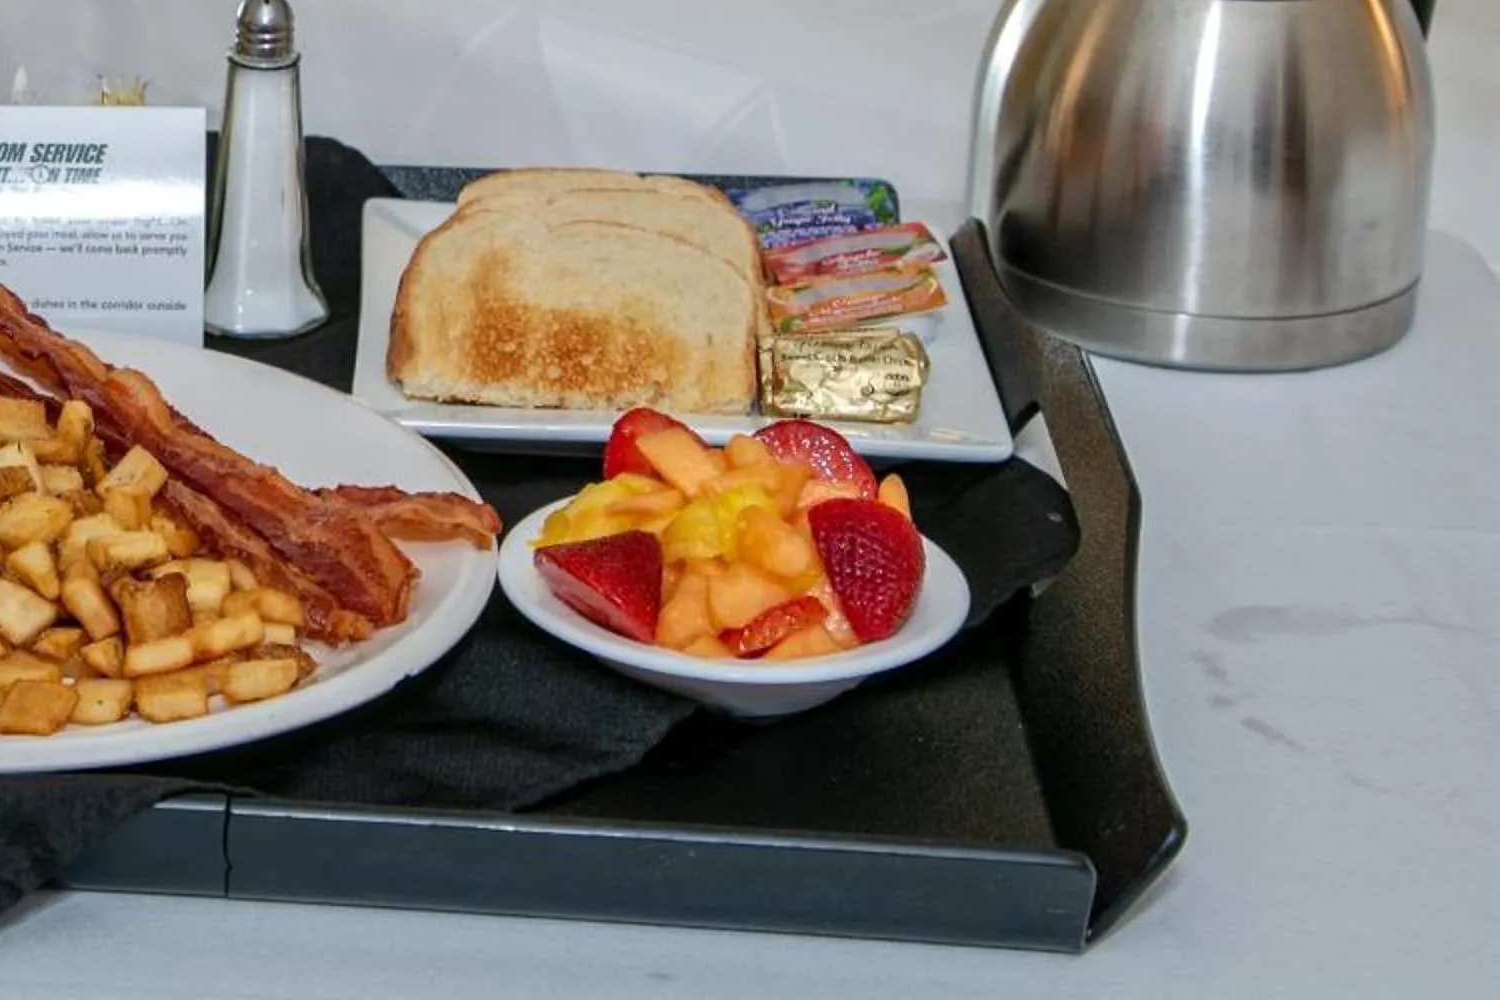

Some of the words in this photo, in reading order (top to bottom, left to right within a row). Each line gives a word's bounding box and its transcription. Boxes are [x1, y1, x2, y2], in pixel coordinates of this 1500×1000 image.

[29, 143, 108, 164] SERVICE
[7, 242, 43, 253] Service
[85, 245, 113, 254] come
[115, 244, 139, 254] back
[141, 245, 188, 257] promptly
[31, 297, 65, 309] dishes
[80, 298, 97, 309] the
[101, 299, 143, 311] corridor
[146, 300, 188, 311] outside
